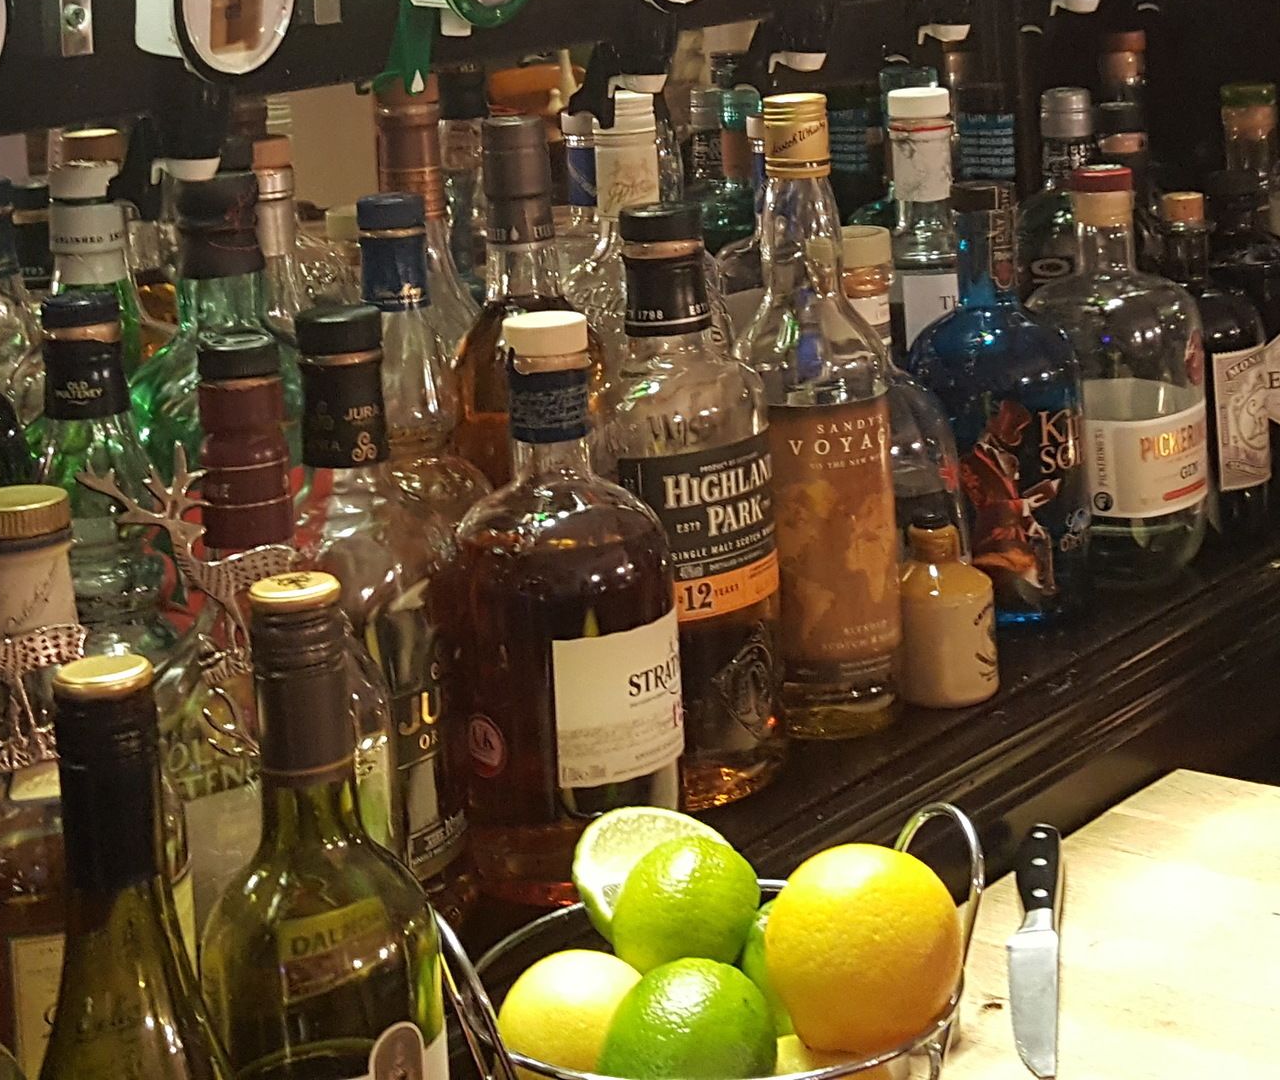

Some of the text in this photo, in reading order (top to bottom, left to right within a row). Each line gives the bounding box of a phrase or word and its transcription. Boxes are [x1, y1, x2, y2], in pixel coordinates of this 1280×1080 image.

[706, 495, 763, 537] PARK
[671, 548, 707, 561] SINGLE
[684, 582, 712, 612] 12
